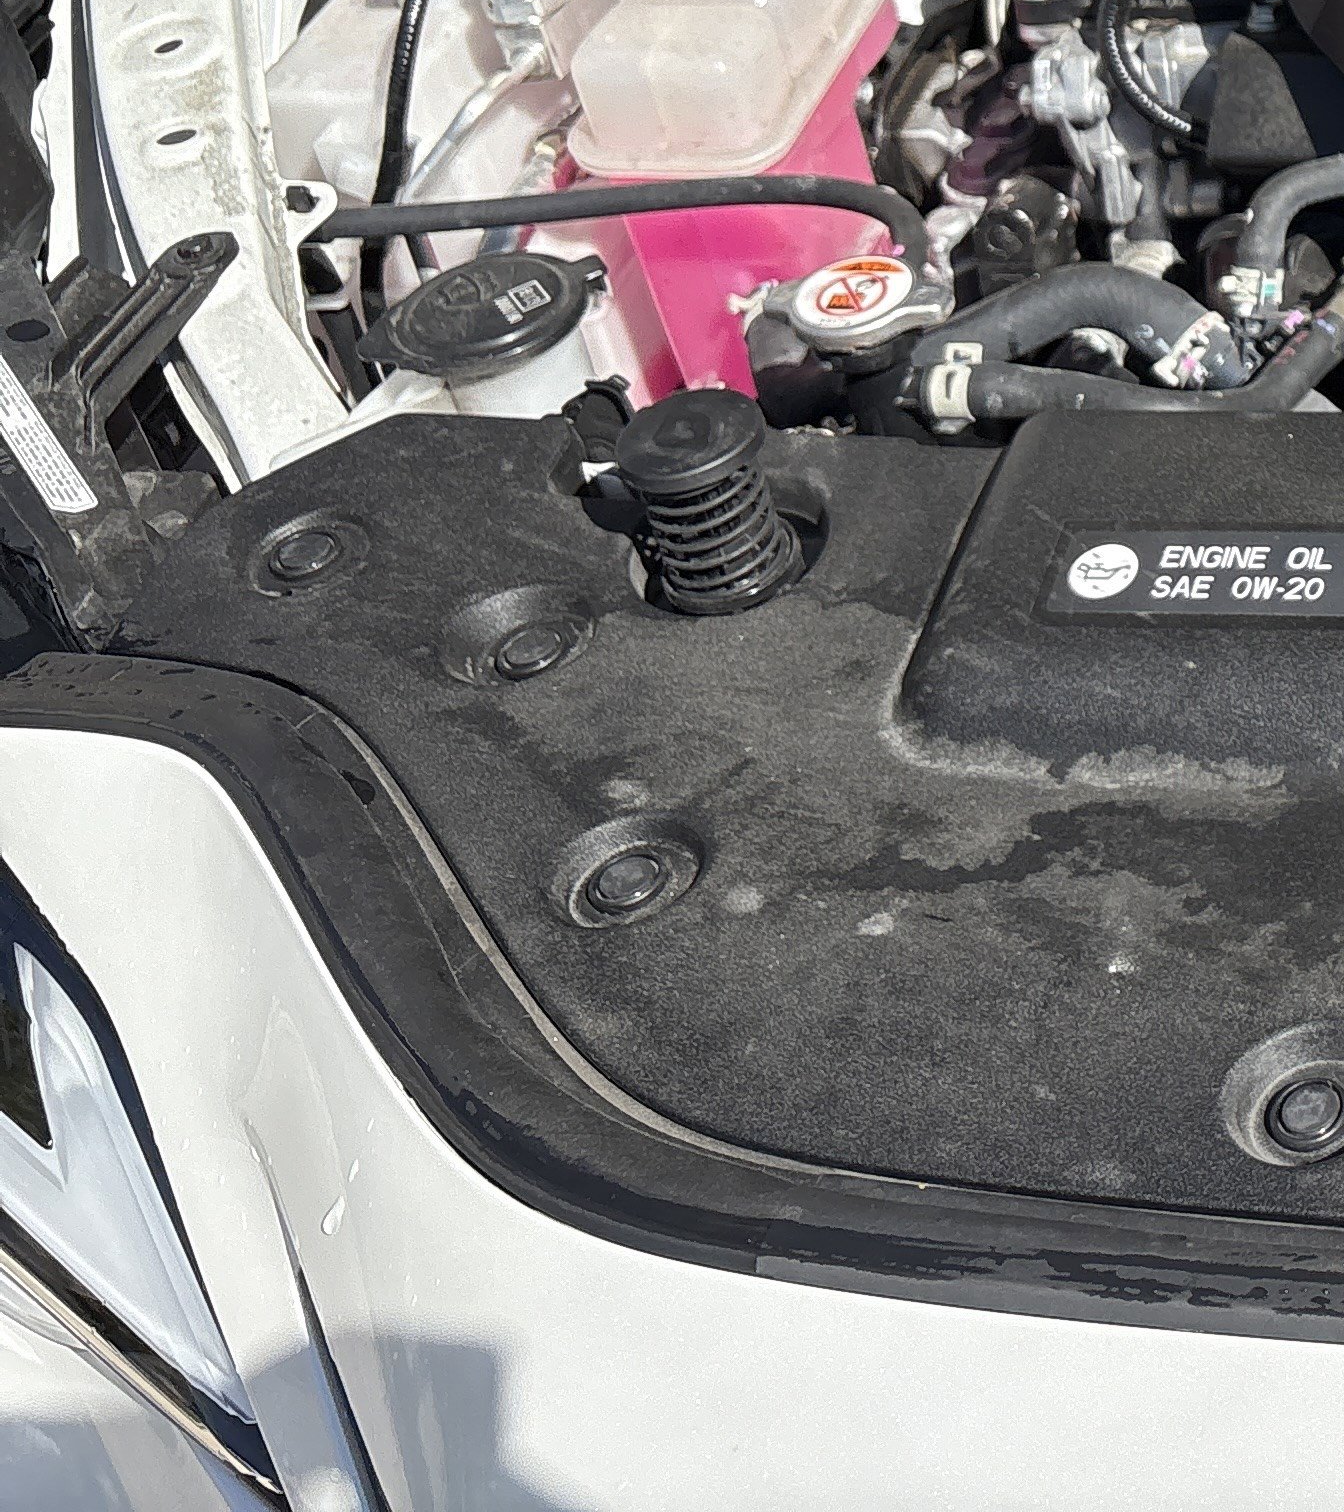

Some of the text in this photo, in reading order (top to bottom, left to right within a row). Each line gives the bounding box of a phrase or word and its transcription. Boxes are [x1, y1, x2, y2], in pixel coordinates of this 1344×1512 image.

[1159, 545, 1333, 570] ENGINE OIL
[1150, 575, 1325, 601] SAE 0W-20
